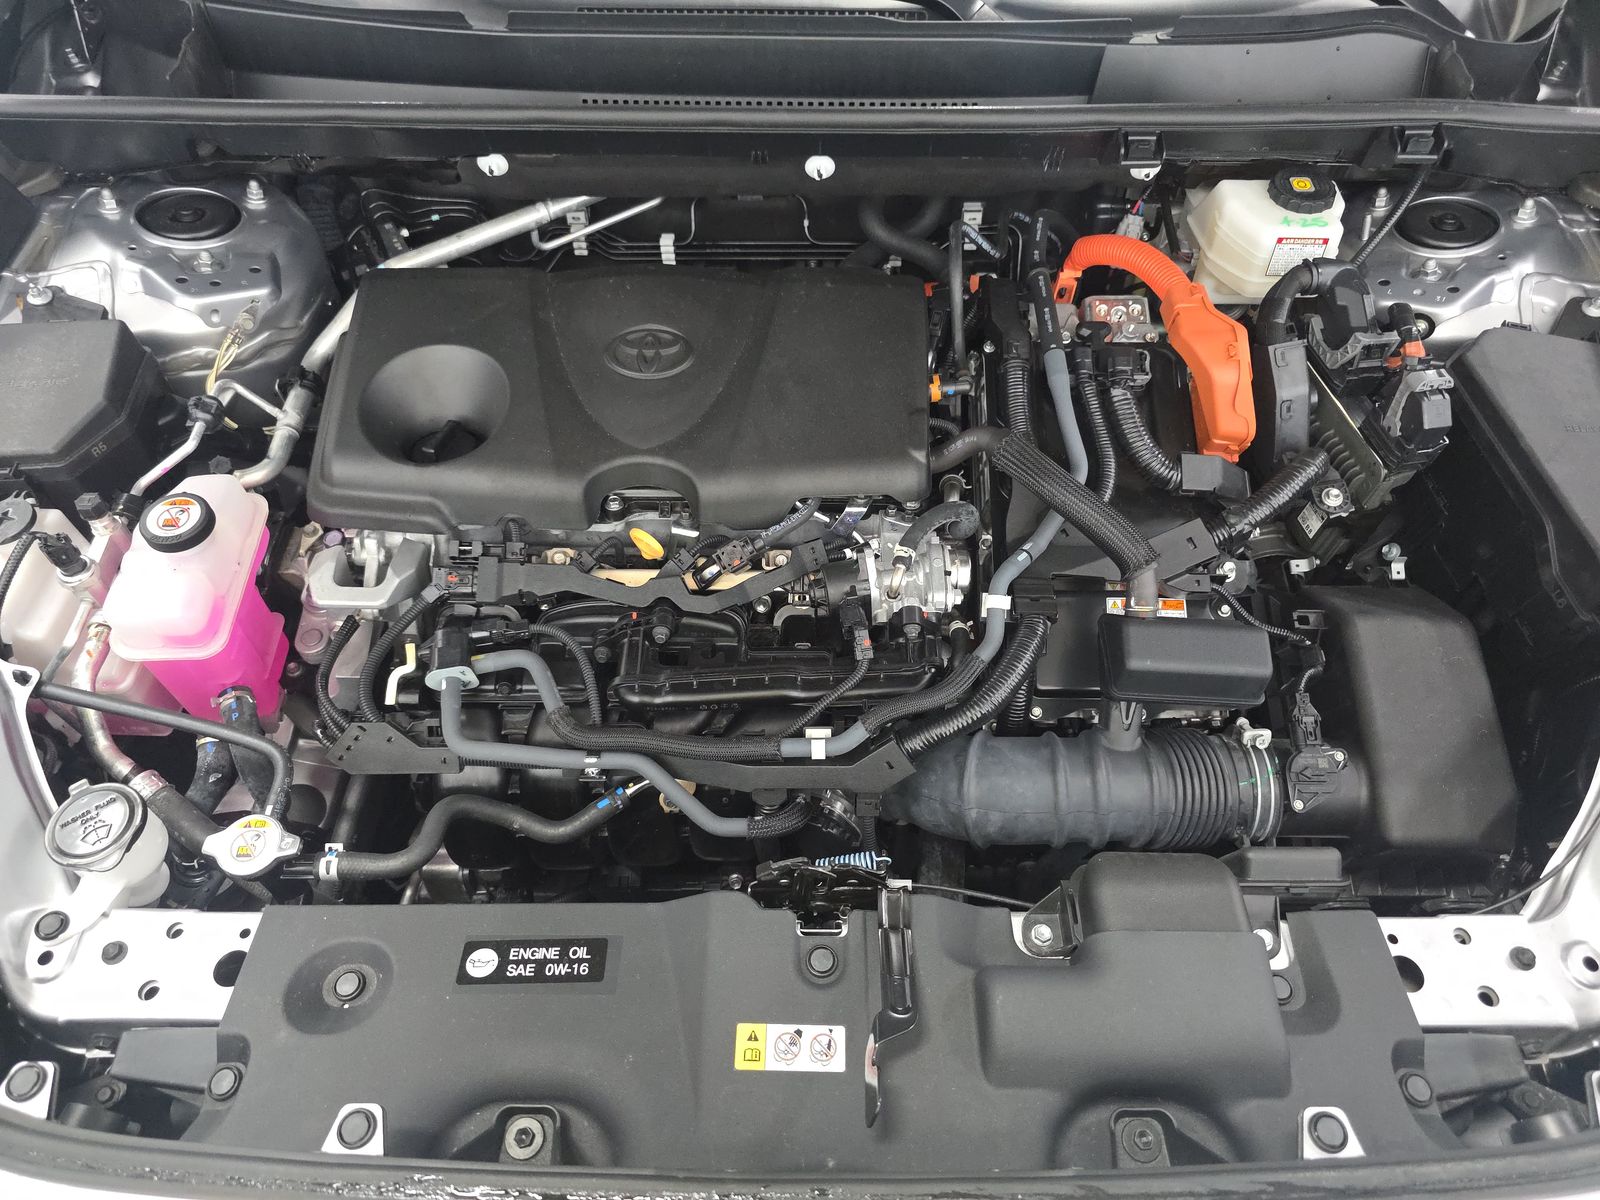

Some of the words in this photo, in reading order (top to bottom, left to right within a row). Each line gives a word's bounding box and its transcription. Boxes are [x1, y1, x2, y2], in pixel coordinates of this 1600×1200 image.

[91, 441, 107, 457] R5
[59, 809, 92, 829] WASHER
[94, 796, 117, 811] FLUID
[80, 811, 100, 826] ONLY
[509, 947, 560, 960] ENGINE
[568, 946, 591, 959] OIL
[506, 963, 535, 977] SAE
[545, 963, 589, 976] 0W-16
